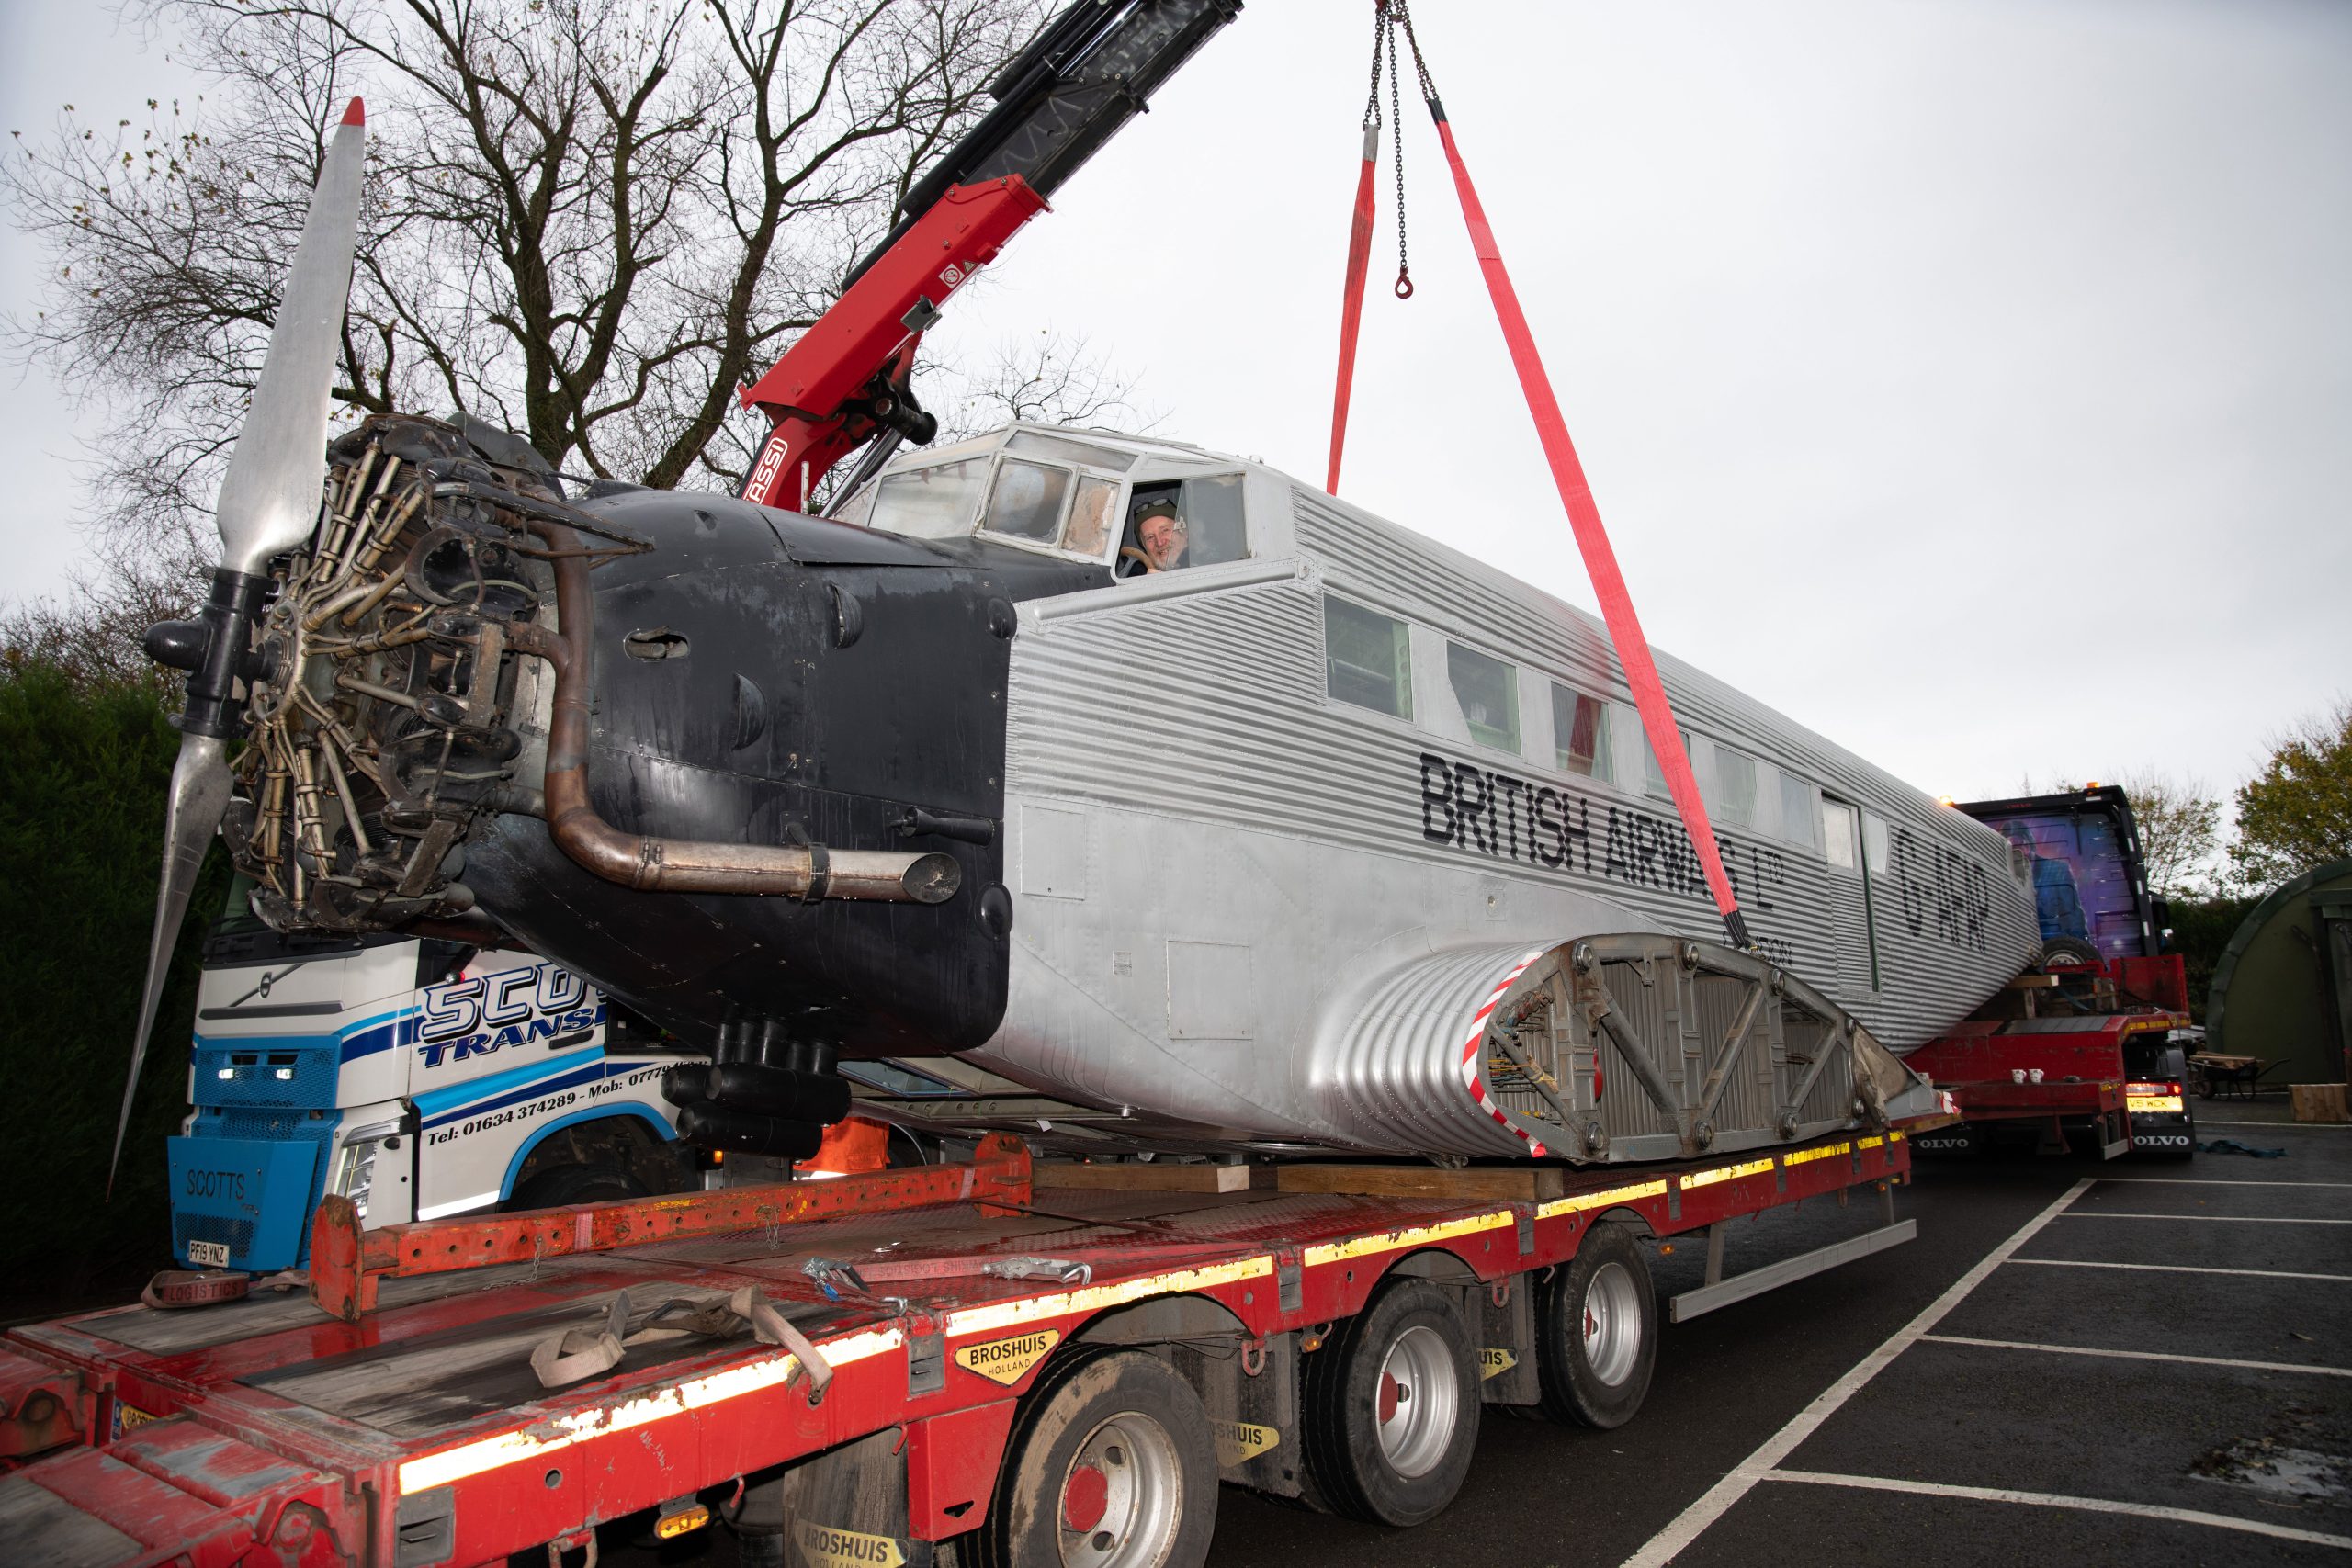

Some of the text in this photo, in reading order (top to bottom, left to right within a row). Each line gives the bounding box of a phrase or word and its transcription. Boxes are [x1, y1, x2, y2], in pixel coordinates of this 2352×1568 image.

[745, 444, 784, 502] ASSI
[1420, 752, 1591, 874] BRITISH
[1605, 807, 1739, 901] AIRWAS
[421, 962, 606, 1044] SCO
[428, 1129, 458, 1146] Tel:
[462, 1110, 514, 1136] 01634
[517, 1092, 576, 1120] 374289
[588, 1079, 623, 1099] Mob:
[1917, 1138, 1969, 1148] OLVO
[2132, 1135, 2189, 1145] OLVO
[187, 1169, 245, 1200] SCOTTS
[190, 1242, 225, 1264] PF19 YNZ
[169, 1280, 238, 1302] LOGISTICS
[970, 1336, 1046, 1365] BROSHUIS
[989, 1359, 1031, 1376] HOLLAND
[1215, 1422, 1263, 1445] SHUIS
[805, 1527, 888, 1563] BROSHUIS
